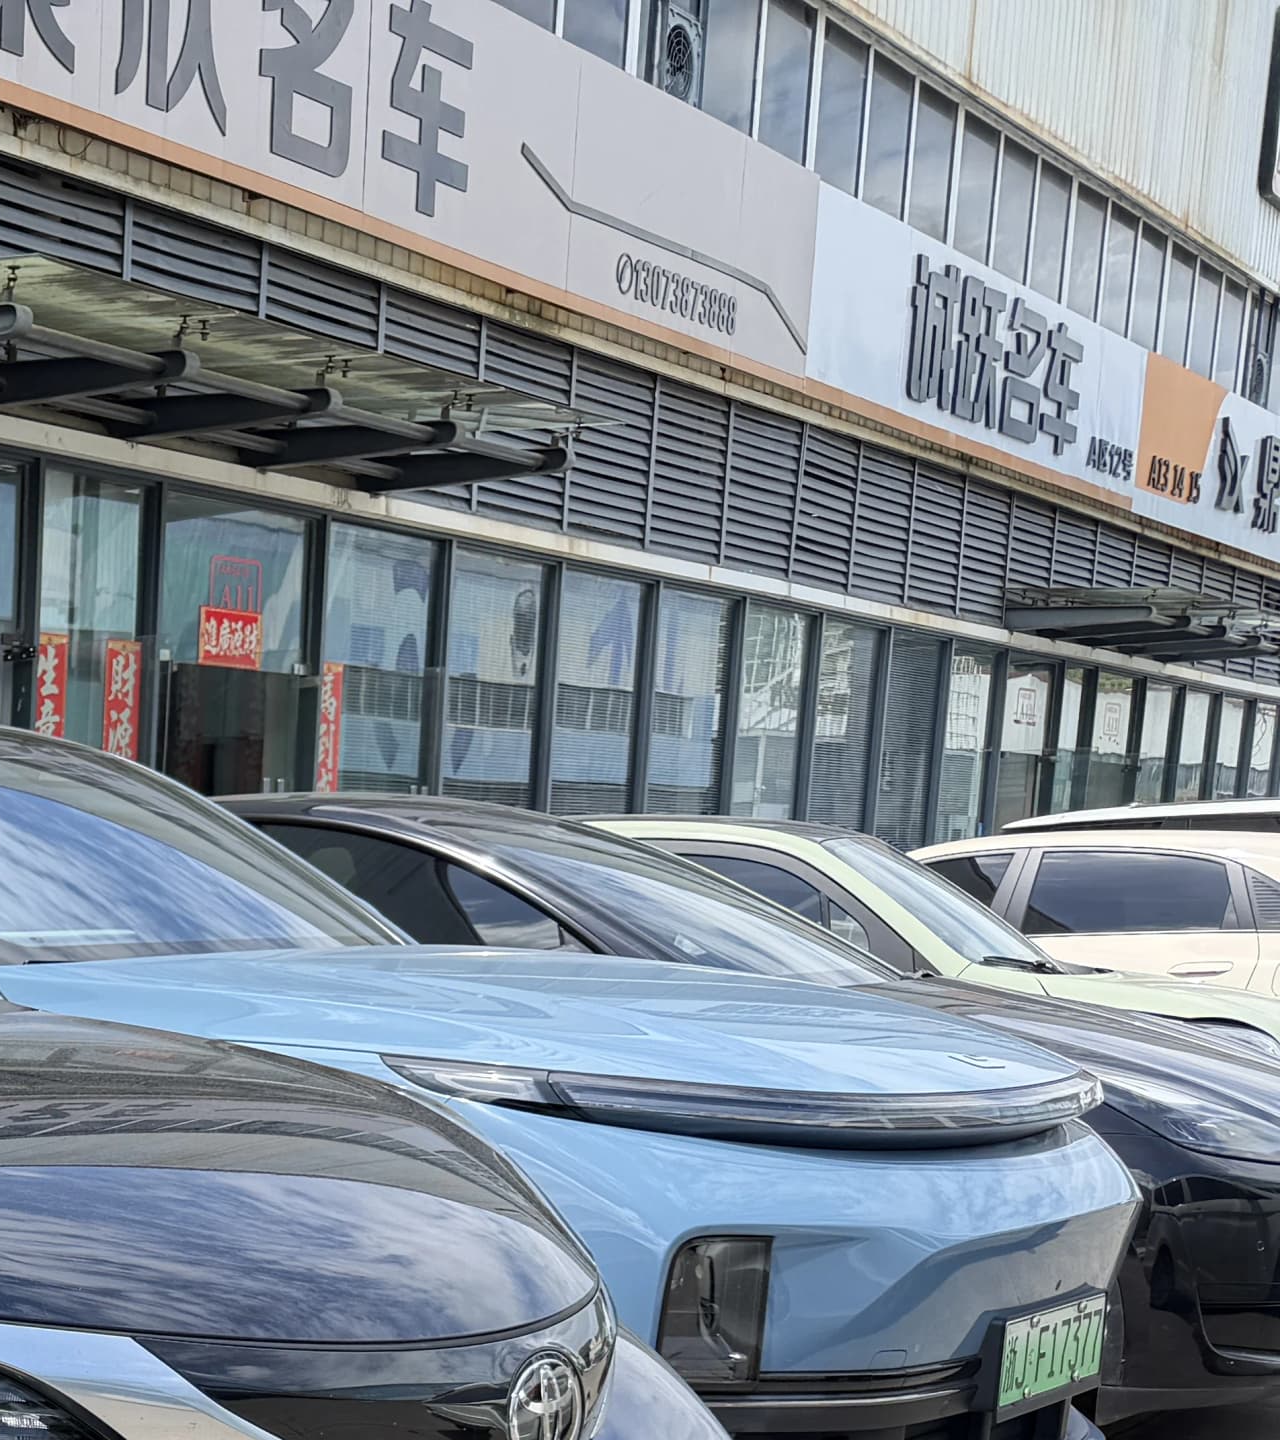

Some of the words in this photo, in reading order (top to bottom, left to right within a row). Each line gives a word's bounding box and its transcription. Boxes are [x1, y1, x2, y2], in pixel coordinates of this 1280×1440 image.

[634, 259, 738, 336] 13073873888
[1085, 436, 1133, 481] A区12号
[1147, 455, 1171, 492] A13
[1170, 464, 1186, 498] 14
[1187, 471, 1201, 504] 15
